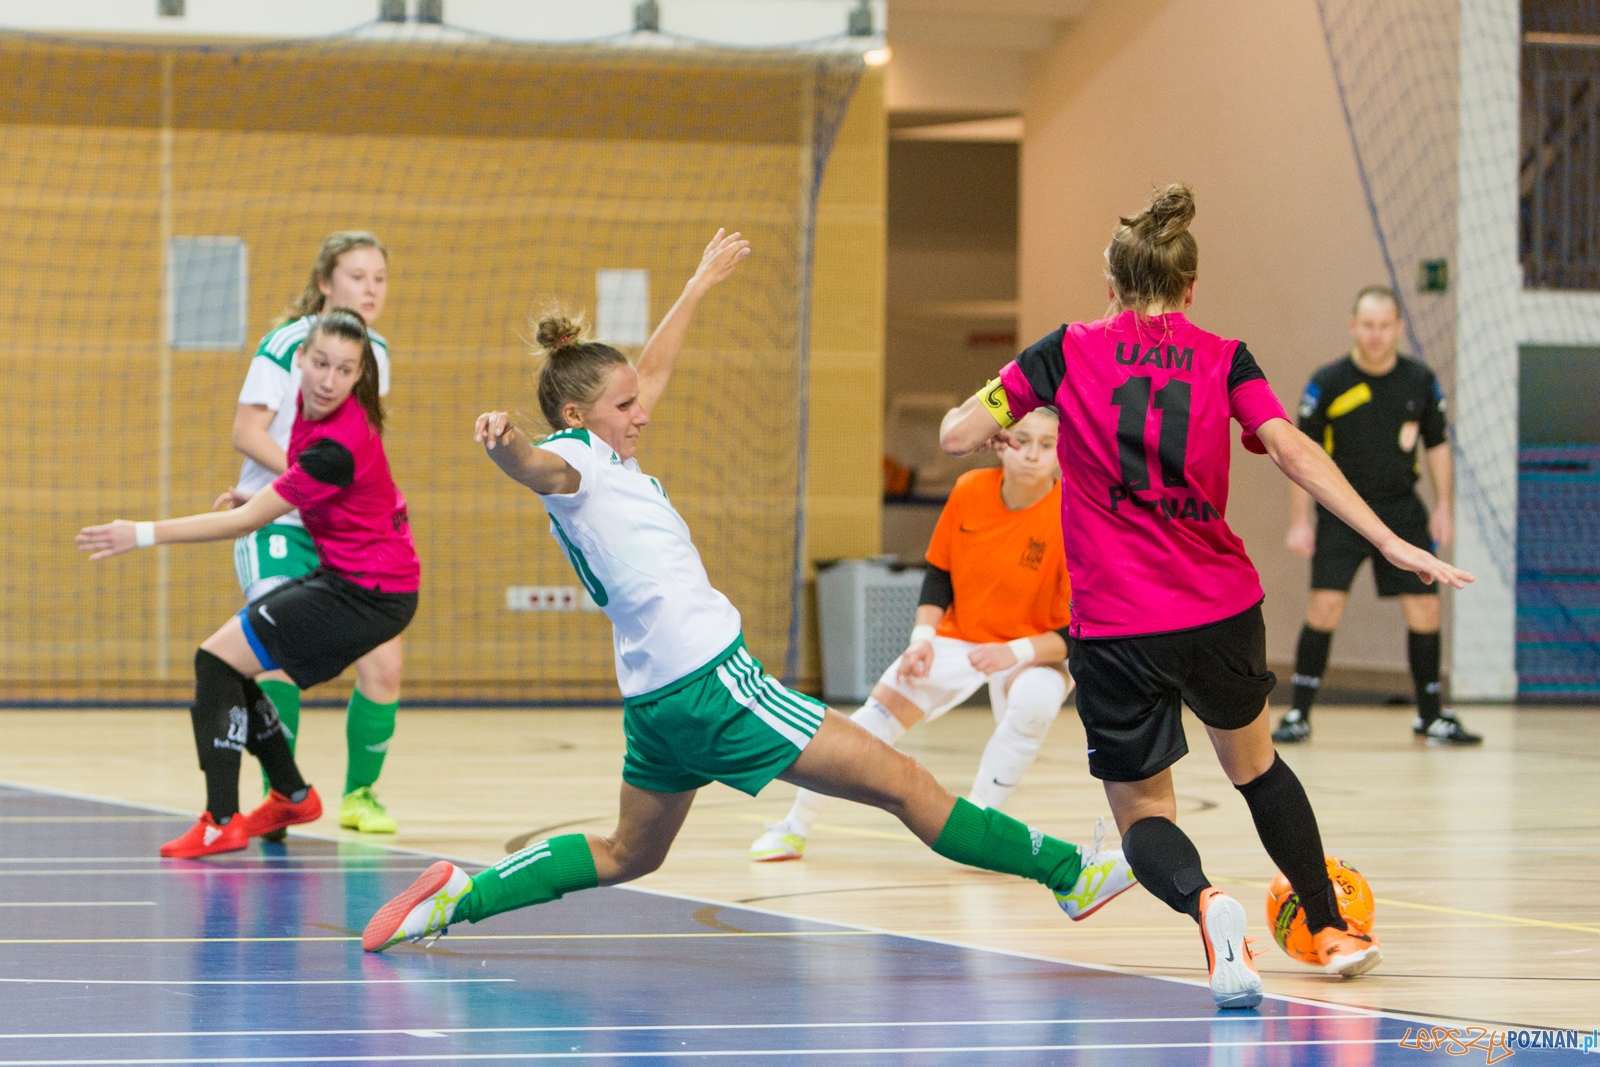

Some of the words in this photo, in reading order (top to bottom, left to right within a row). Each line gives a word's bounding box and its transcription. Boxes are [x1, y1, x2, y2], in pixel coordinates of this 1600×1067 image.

[1114, 342, 1194, 371] UAM
[1111, 375, 1192, 491] 11
[269, 534, 288, 559] 8
